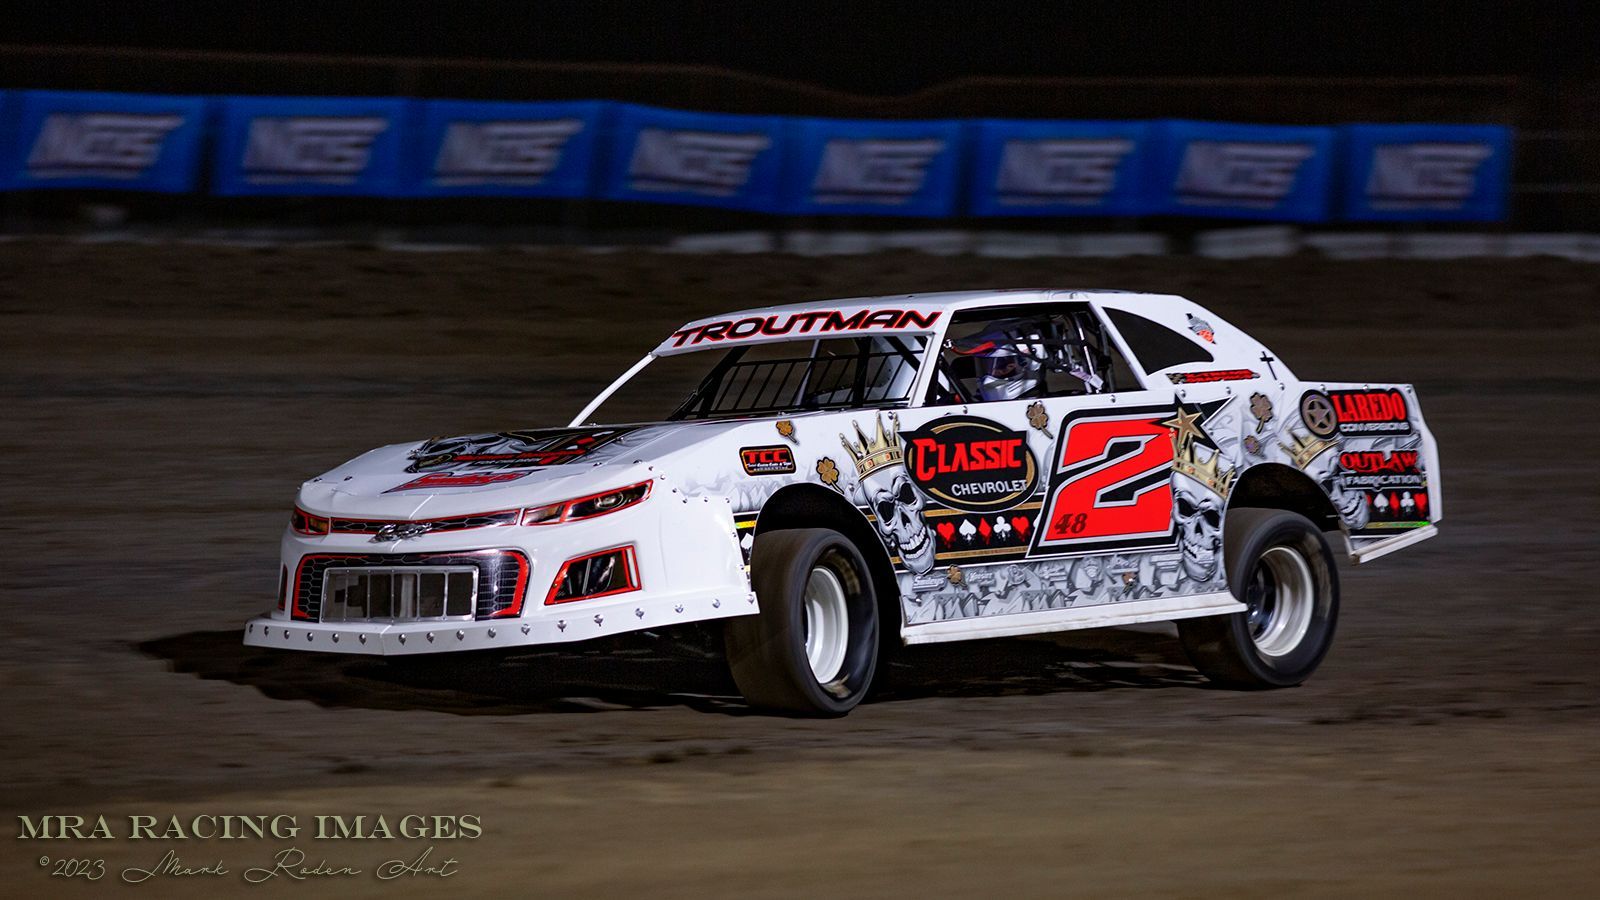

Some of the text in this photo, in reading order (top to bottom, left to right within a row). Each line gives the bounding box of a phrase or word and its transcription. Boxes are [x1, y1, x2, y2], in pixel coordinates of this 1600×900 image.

[672, 309, 943, 348] TROUTMAN
[1331, 393, 1407, 422] LAREDO
[744, 449, 788, 463] TCC
[1340, 451, 1419, 473] OUTLAW
[951, 479, 1028, 496] CHEVROLET
[1040, 414, 1176, 545] 2
[1054, 513, 1087, 534] 48
